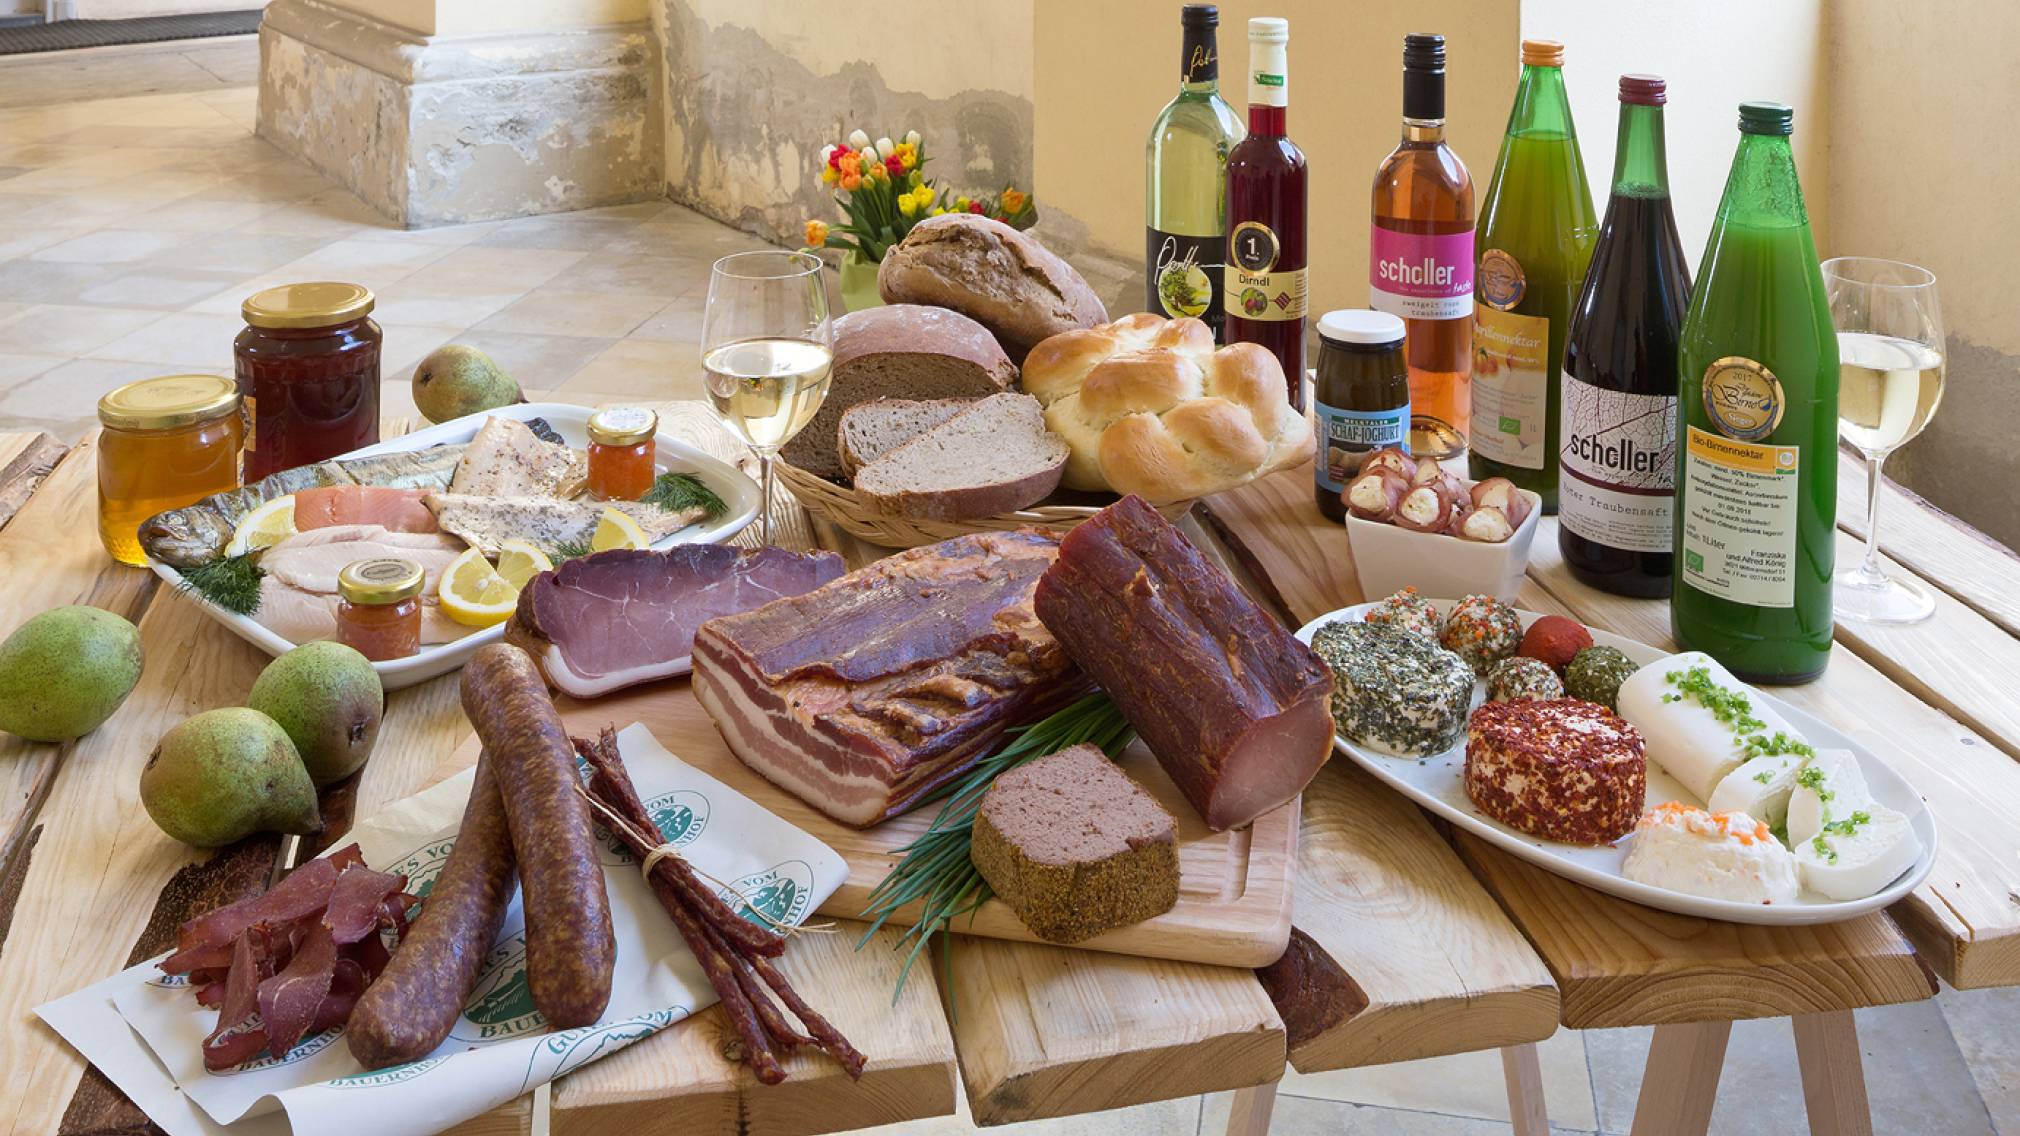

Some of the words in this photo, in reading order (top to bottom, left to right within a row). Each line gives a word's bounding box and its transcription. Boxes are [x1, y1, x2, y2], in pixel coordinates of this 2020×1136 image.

[1239, 273, 1270, 287] Dirndl
[1588, 495, 1669, 517] Traubensaft
[426, 843, 455, 858] VO
